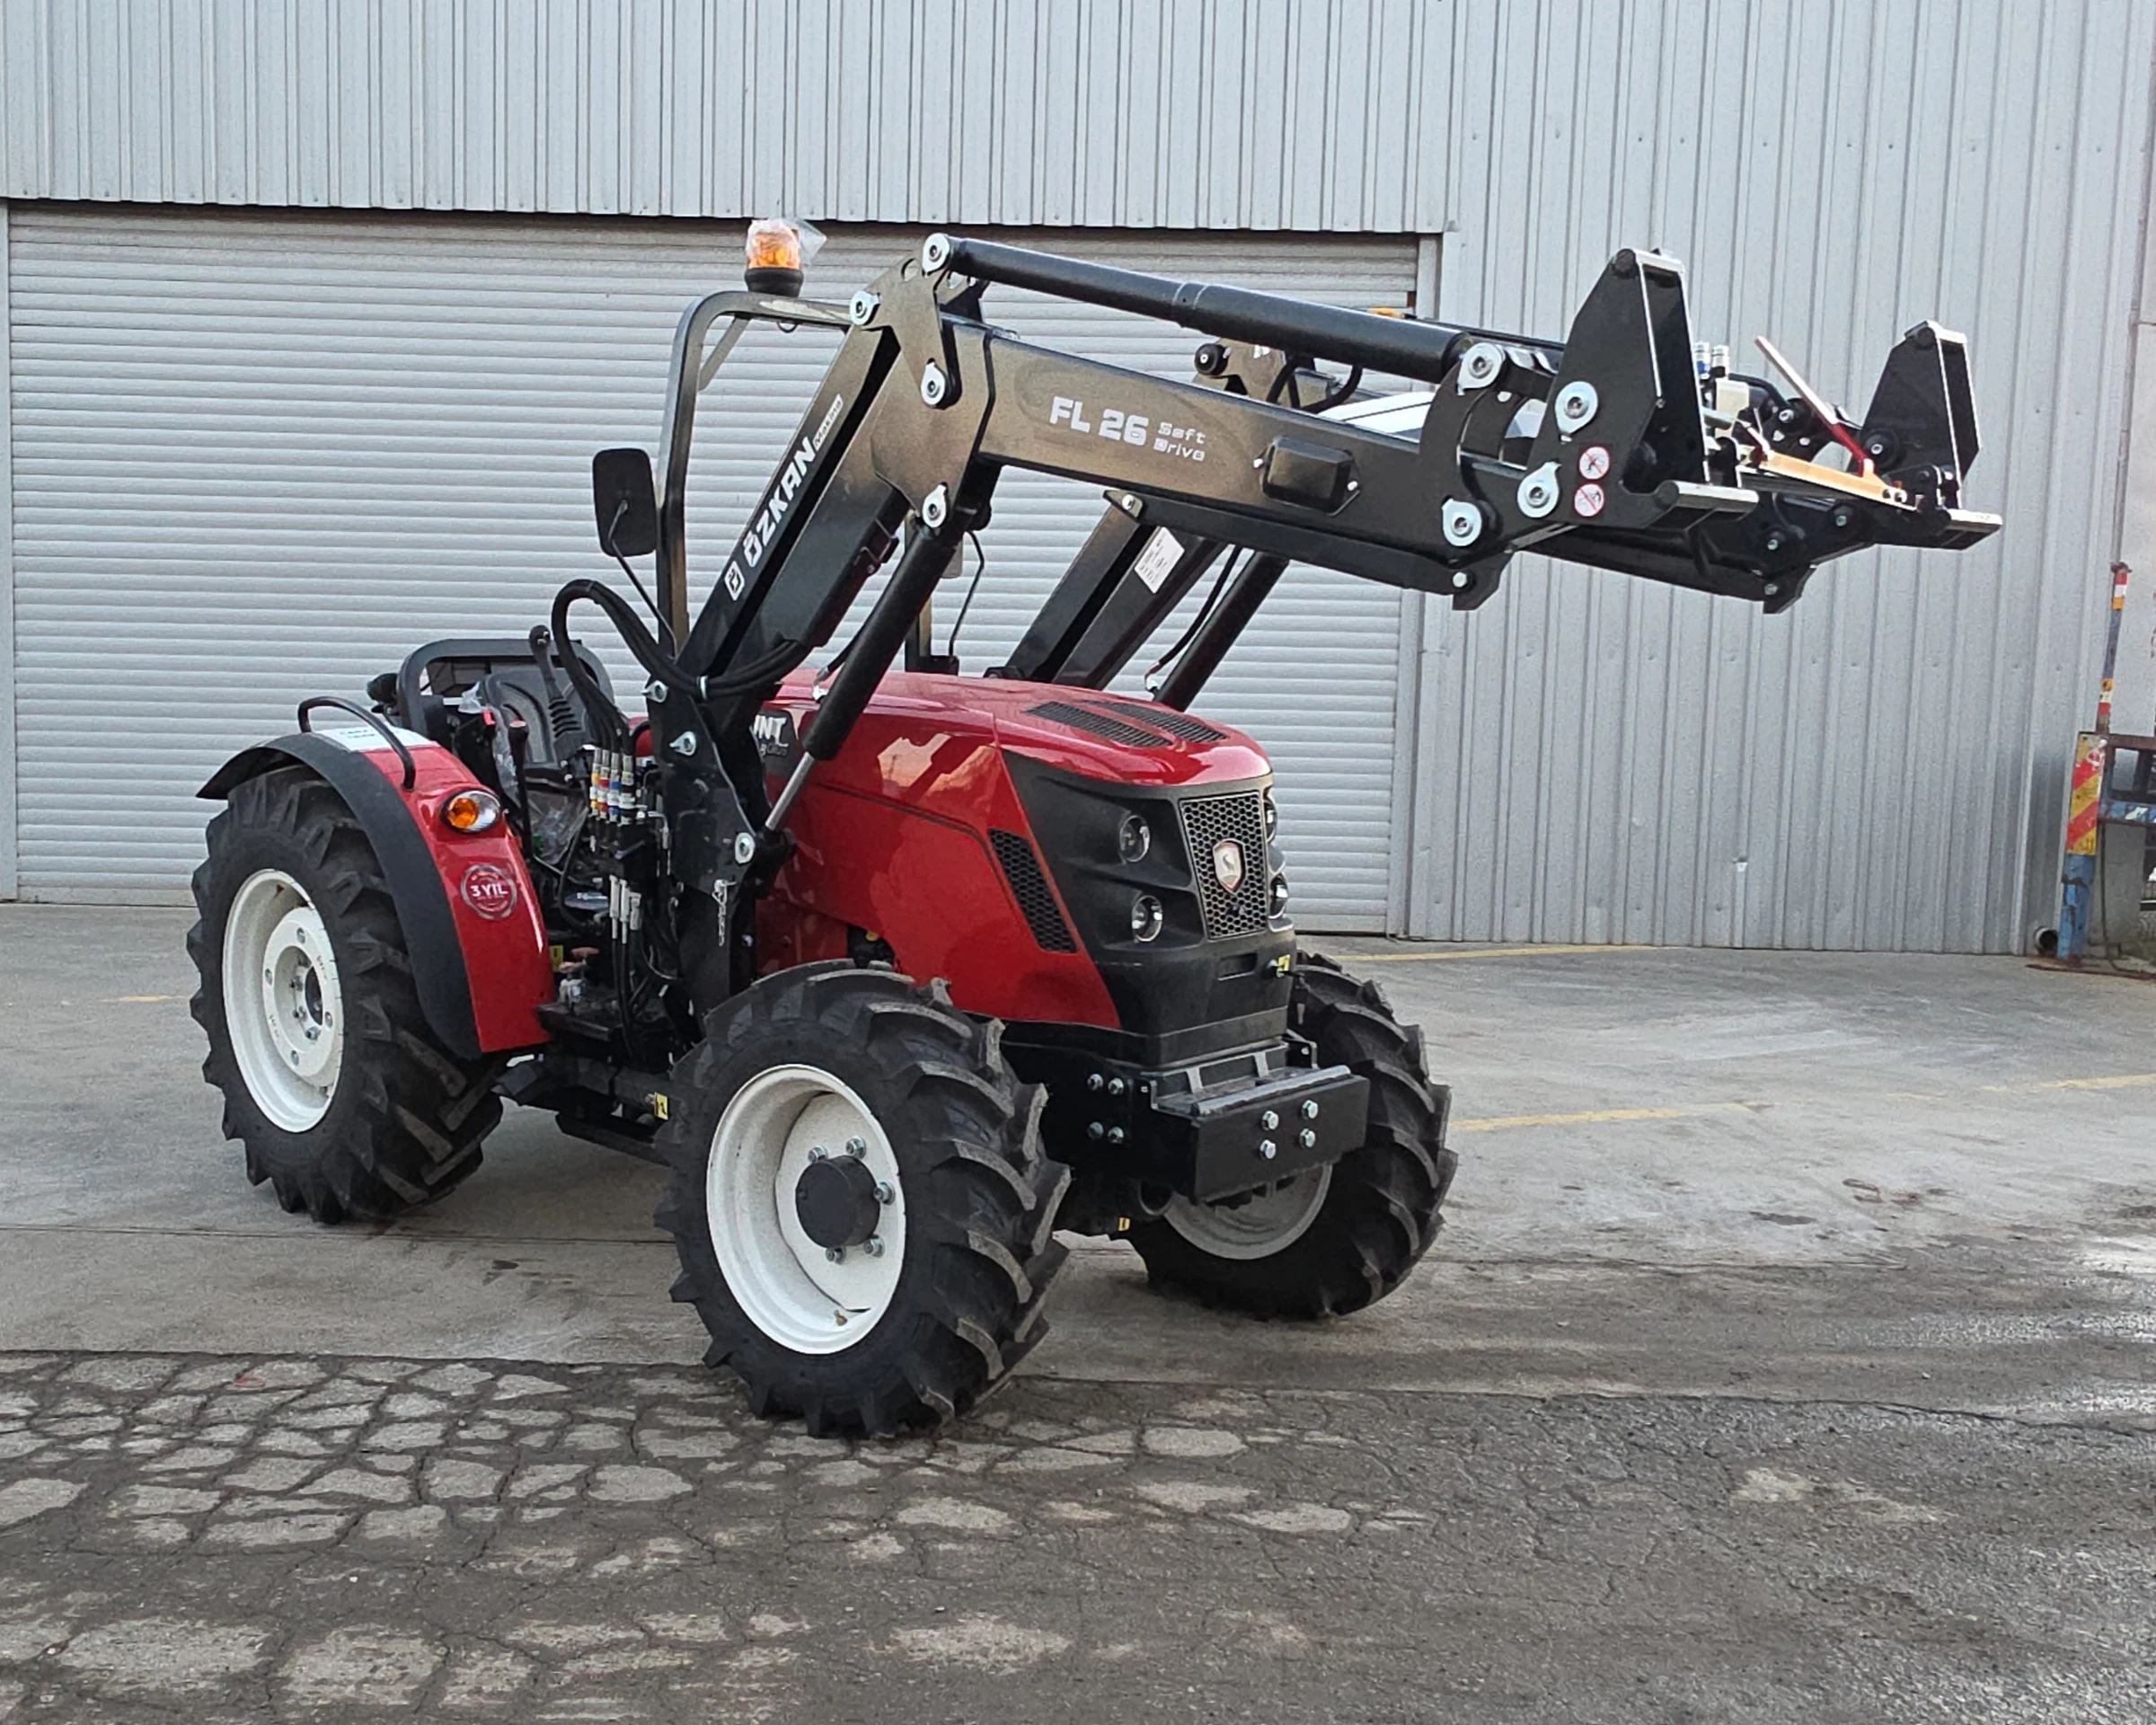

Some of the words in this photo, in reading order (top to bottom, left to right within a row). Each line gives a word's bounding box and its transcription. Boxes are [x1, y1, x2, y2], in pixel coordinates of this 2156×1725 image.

[1049, 396, 1091, 433] FL
[1099, 409, 1149, 446] 26
[1153, 438, 1206, 461] Drive
[743, 437, 817, 568] ÖZKAN
[470, 885, 482, 898] 3
